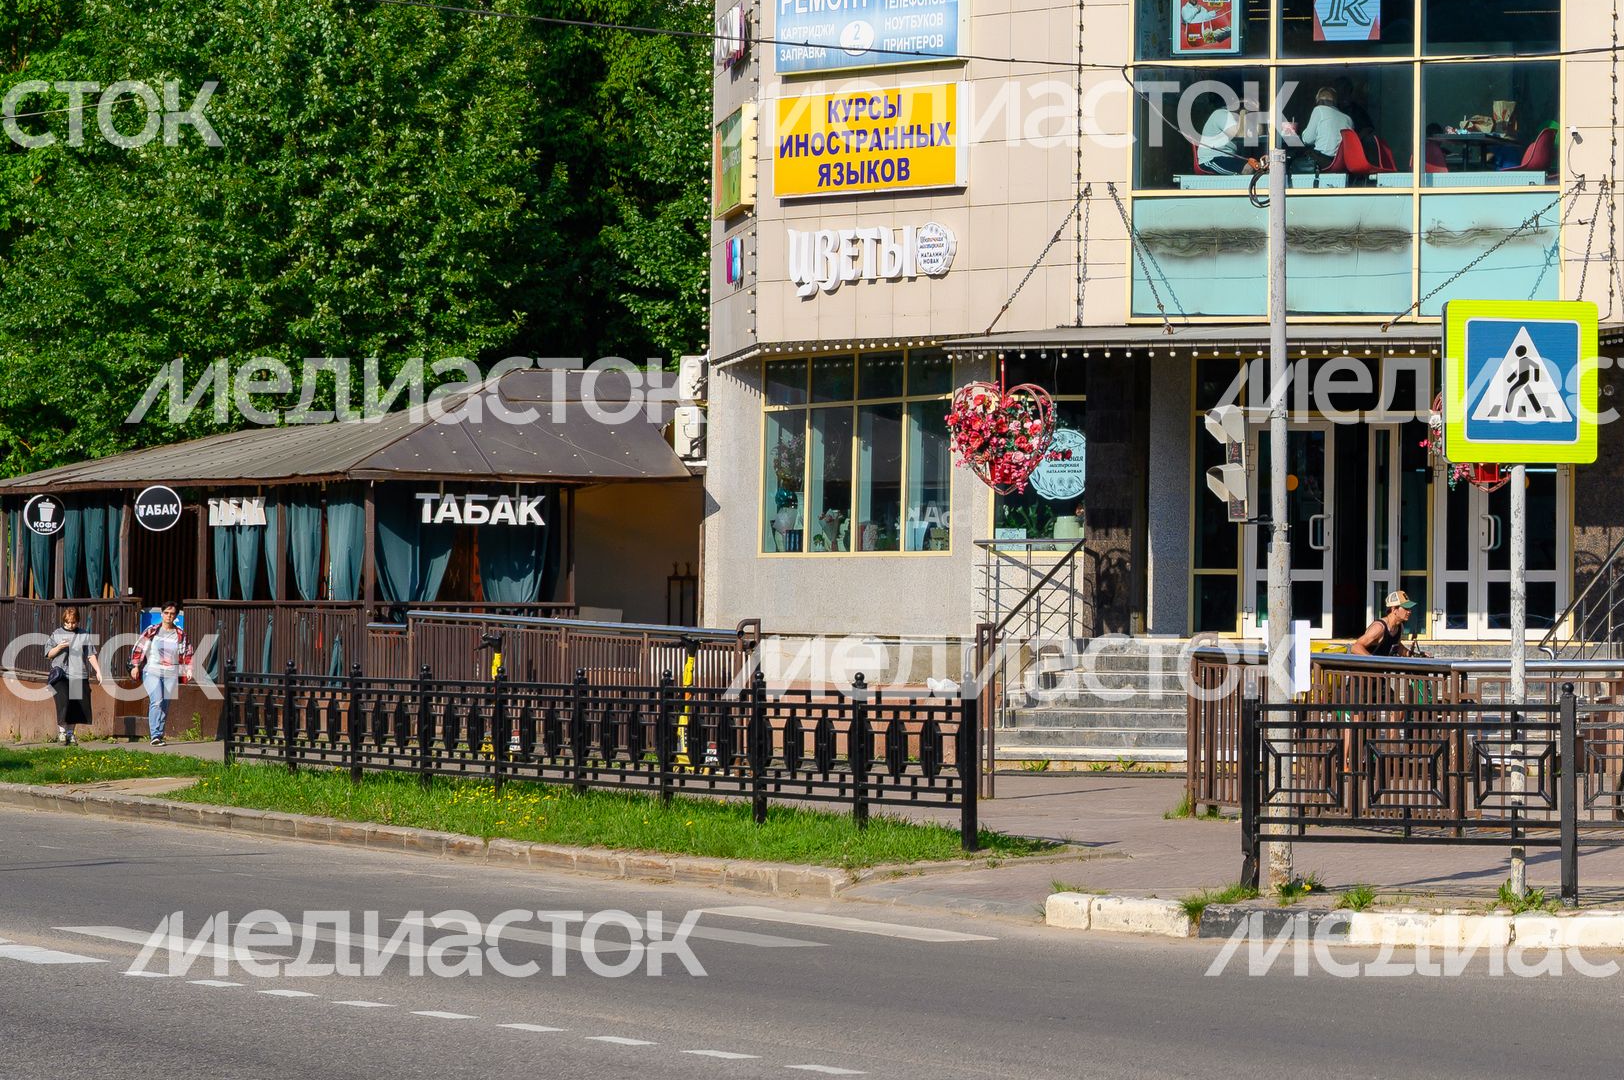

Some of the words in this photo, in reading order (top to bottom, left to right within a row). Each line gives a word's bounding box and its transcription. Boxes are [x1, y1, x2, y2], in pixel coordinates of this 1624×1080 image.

[884, 13, 944, 31] НОУТБУКОВ
[780, 23, 835, 40] КАРТРИДЖИ
[883, 34, 944, 51] ПРИНТЕРОВ
[780, 47, 827, 62] ЗАПРАВКА
[828, 94, 903, 124] КУРСЫ
[779, 122, 951, 159] ИНОСТРАННЫХ
[817, 157, 910, 188] ЯЗЫКОВ
[787, 225, 917, 298] ЦВЕТЫ
[138, 503, 178, 517] ТАБАК
[415, 493, 546, 526] ТАБАК
[33, 521, 58, 529] КОФЕ
